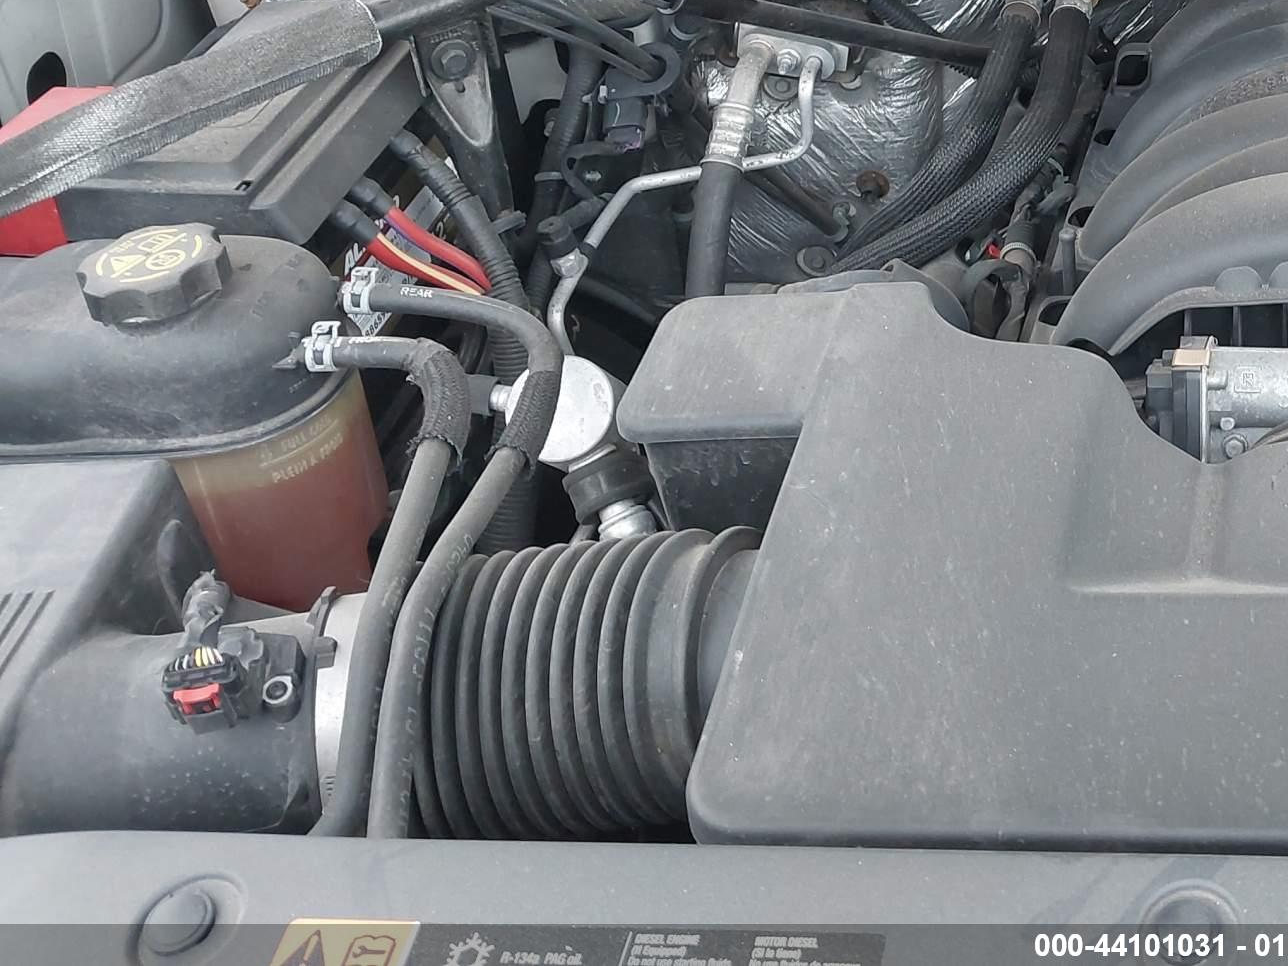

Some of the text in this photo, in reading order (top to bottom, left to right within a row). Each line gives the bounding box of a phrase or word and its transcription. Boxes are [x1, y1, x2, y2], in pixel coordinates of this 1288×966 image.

[400, 286, 433, 298] REAR
[754, 936, 818, 948] MOTOR DIESEL
[544, 952, 567, 965] PAG
